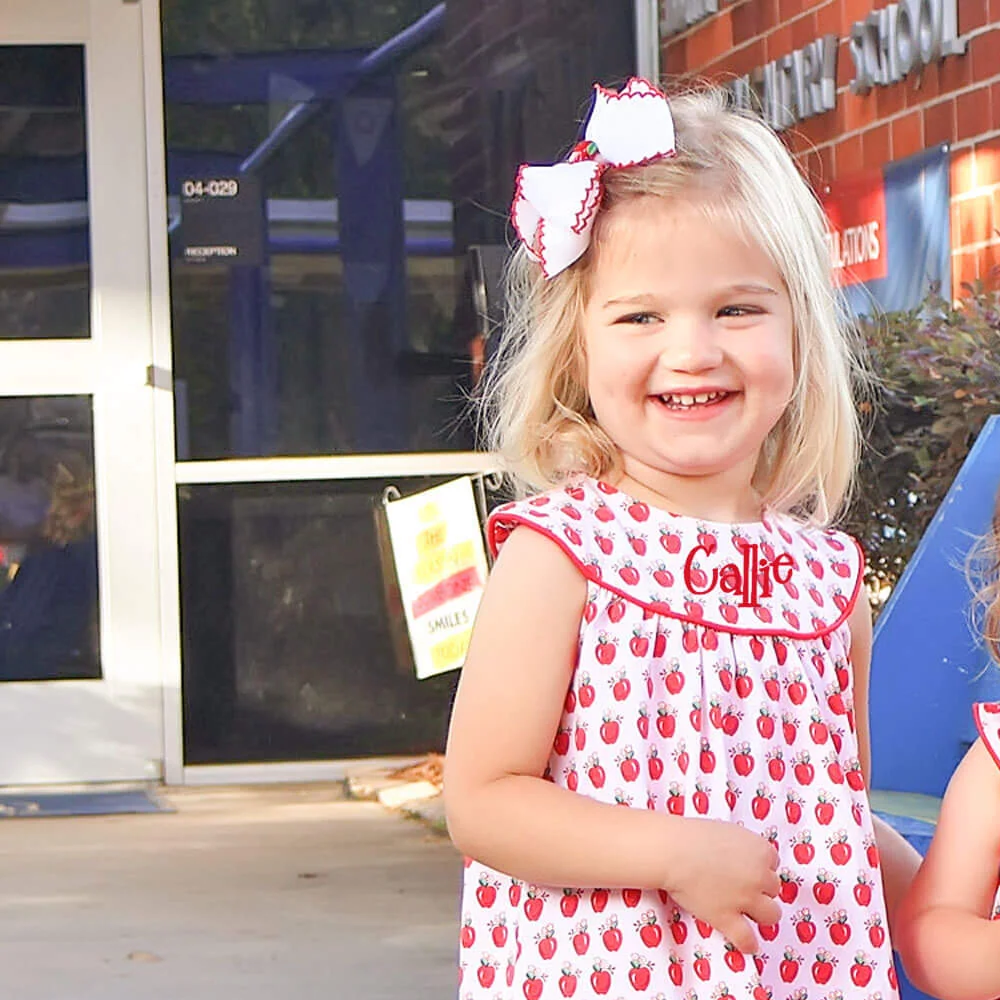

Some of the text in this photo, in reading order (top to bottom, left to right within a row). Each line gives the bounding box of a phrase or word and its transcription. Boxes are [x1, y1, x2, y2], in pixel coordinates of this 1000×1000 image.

[184, 180, 238, 196] 04-029
[684, 544, 794, 607] Callie
[427, 610, 469, 634] SMILES
